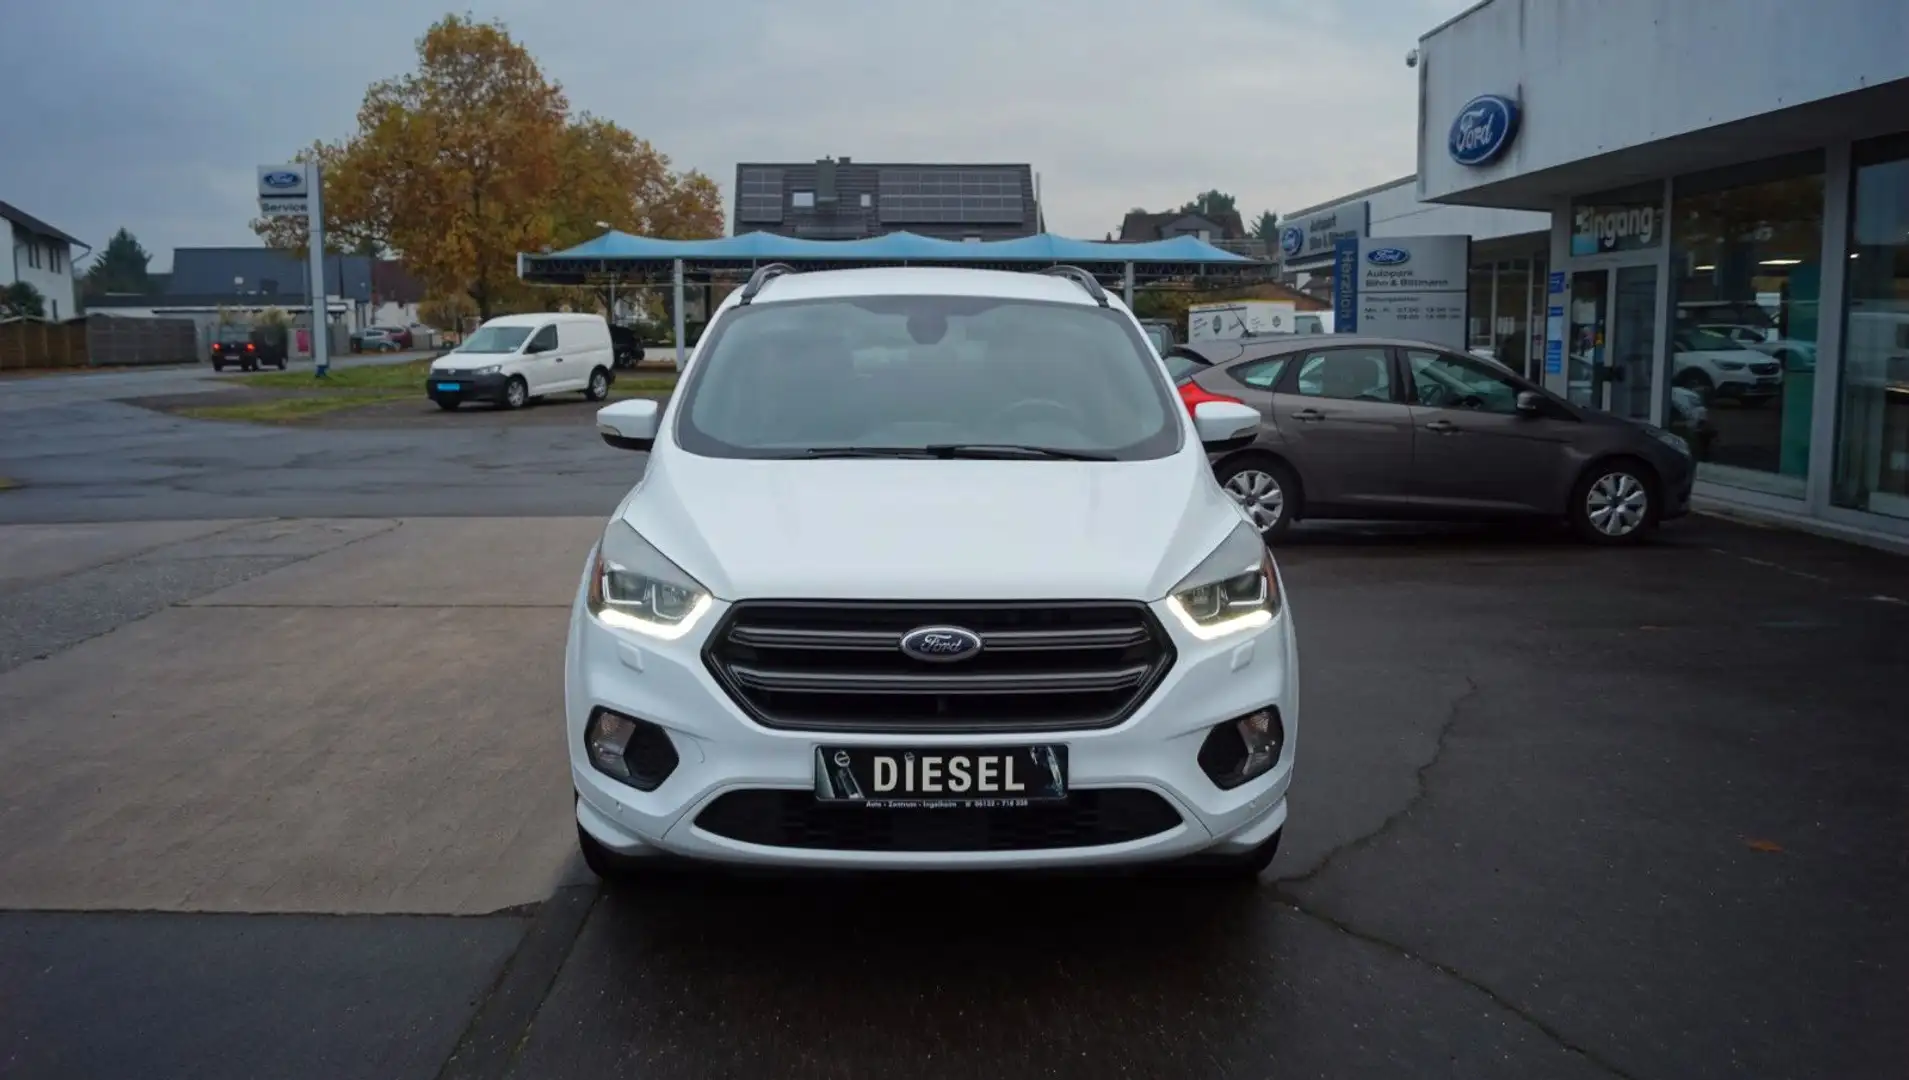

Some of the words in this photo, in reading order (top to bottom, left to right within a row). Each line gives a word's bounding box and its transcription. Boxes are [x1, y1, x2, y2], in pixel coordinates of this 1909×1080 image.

[1456, 108, 1494, 151] Ford
[261, 203, 307, 212] Service
[1576, 206, 1654, 247] Eingang
[1341, 250, 1356, 319] Herzlich
[1366, 269, 1413, 278] Autopark
[921, 634, 962, 653] Ford
[874, 754, 1025, 792] DIESEL
